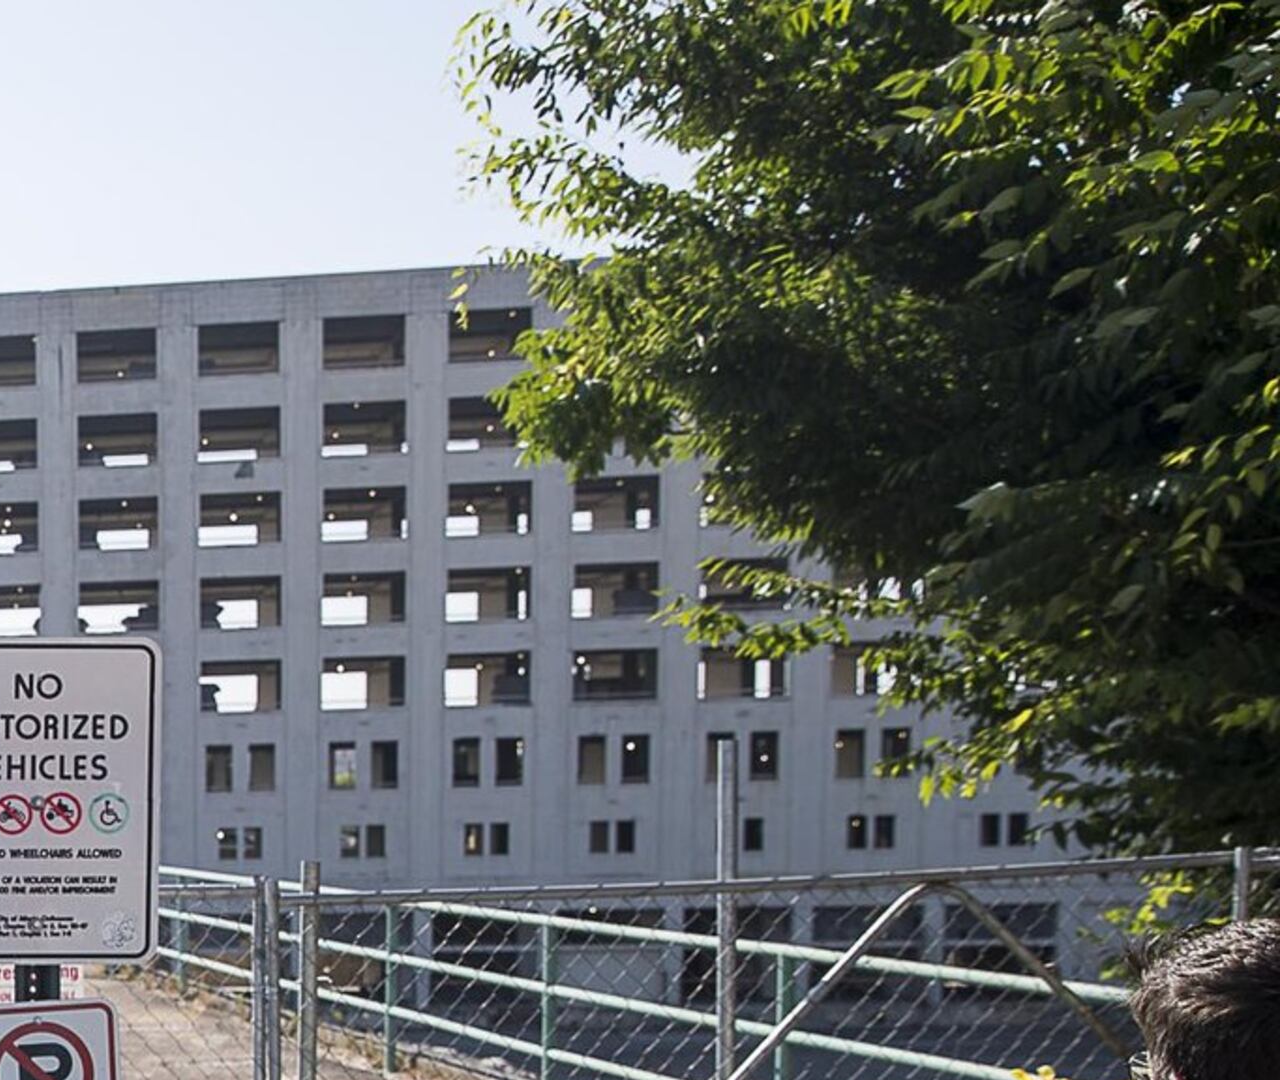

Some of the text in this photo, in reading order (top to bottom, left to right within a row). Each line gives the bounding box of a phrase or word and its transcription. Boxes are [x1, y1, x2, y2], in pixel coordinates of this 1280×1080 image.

[14, 673, 63, 700] NO
[9, 848, 73, 859] WHEELCHAIRS
[77, 848, 122, 859] ALLOWED
[1, 876, 12, 884] OF
[15, 876, 21, 884] A
[23, 876, 62, 884] VIOLATION
[64, 876, 79, 884] CAN
[29, 886, 59, 895] AND/OR
